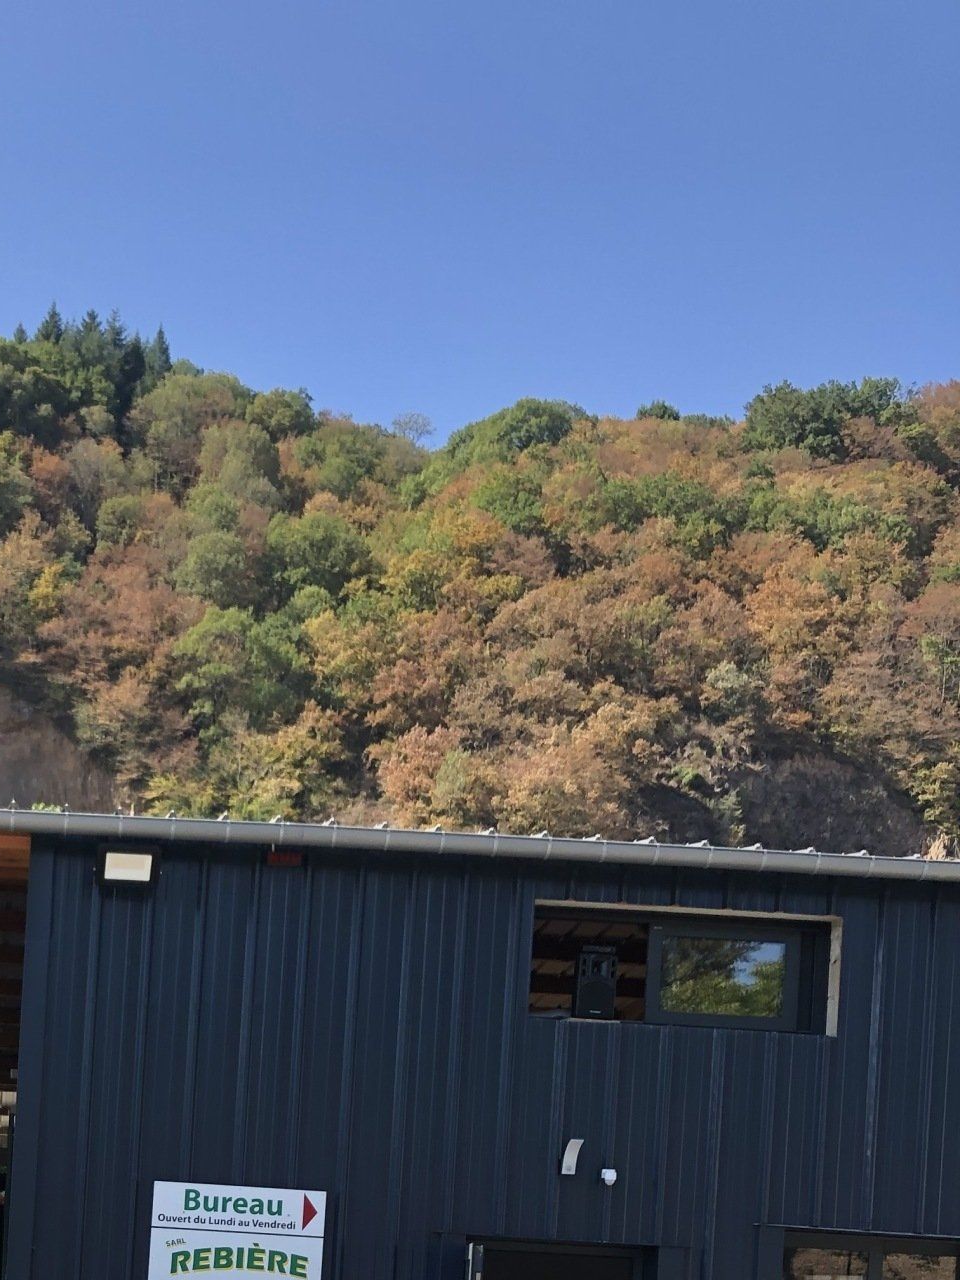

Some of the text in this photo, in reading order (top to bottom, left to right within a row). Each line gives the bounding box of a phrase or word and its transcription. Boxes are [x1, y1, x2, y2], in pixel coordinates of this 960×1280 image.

[183, 1188, 283, 1217] Bureau
[157, 1213, 297, 1230] Ouvert du Lundi au Vendredi
[165, 1237, 187, 1248] SARL
[170, 1242, 309, 1280] REBIÈRE
